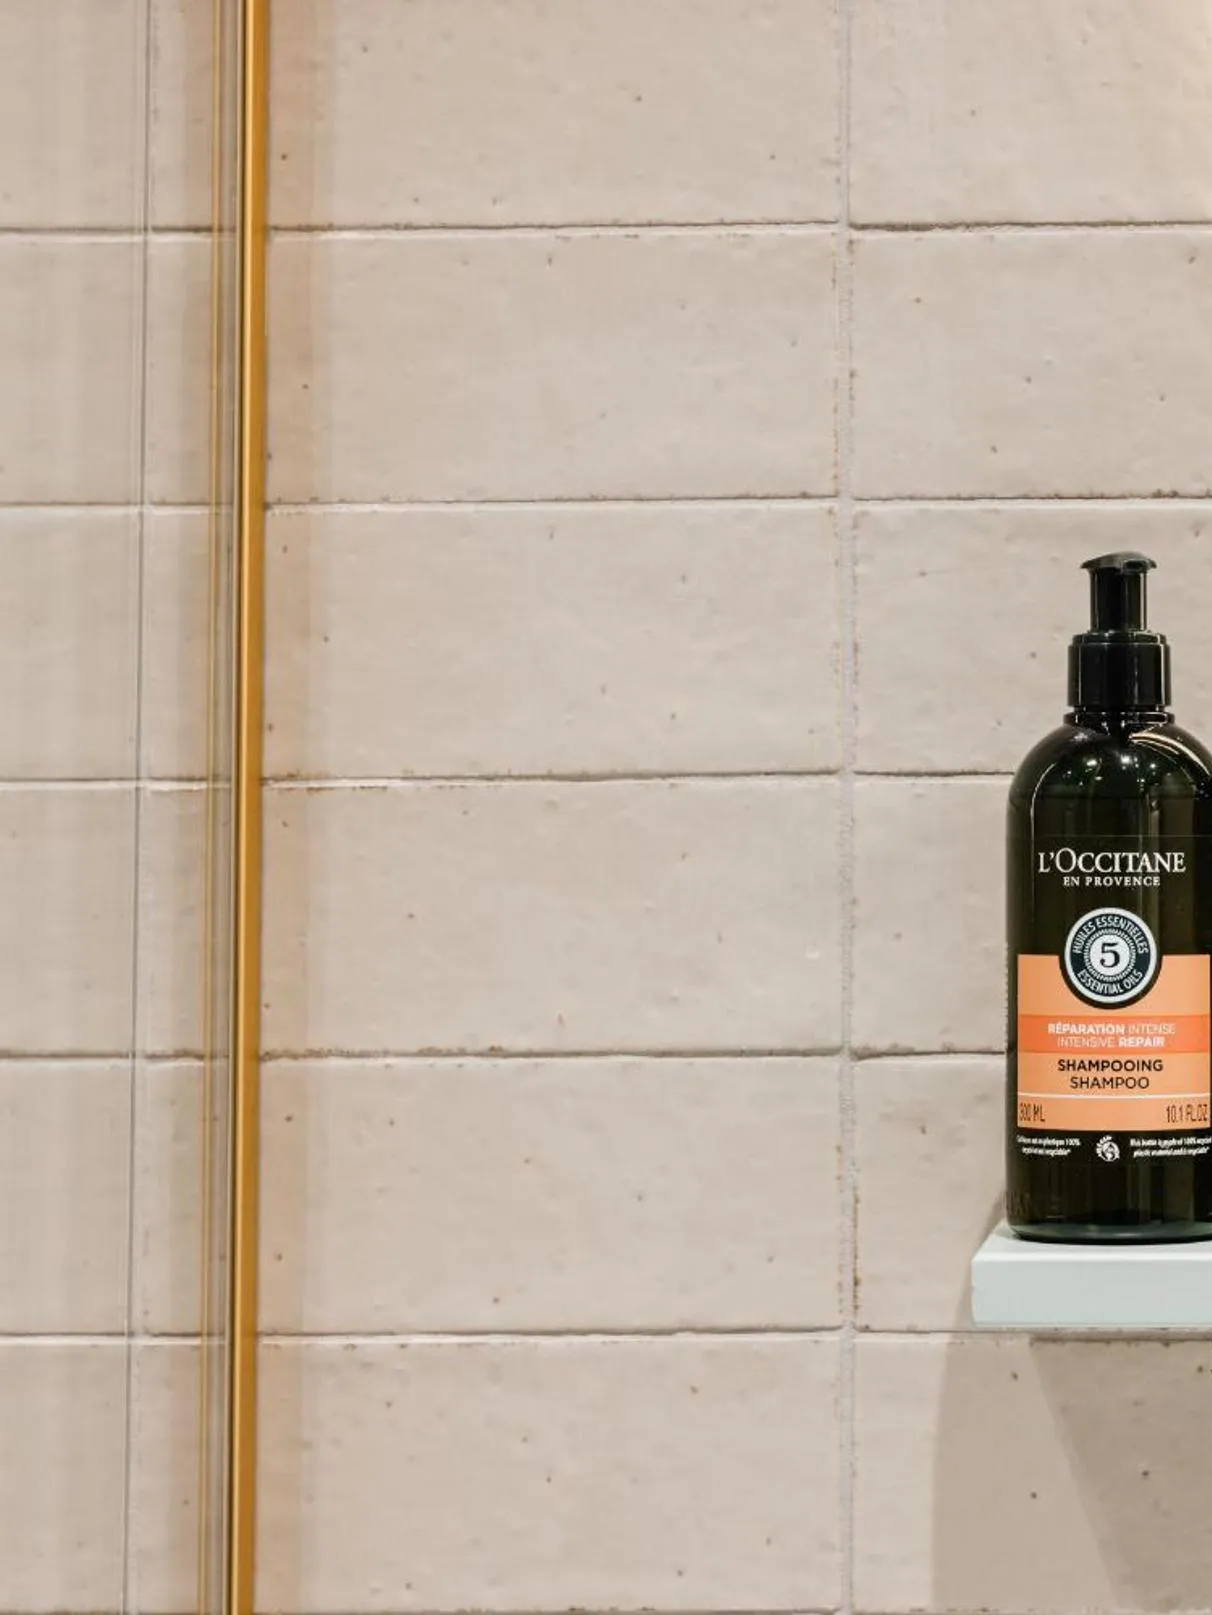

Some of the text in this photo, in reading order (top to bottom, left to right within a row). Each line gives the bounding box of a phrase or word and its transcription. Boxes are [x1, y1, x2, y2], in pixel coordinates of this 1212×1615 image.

[1038, 847, 1186, 873] L'OCCITANE
[1063, 876, 1161, 887] EN PROVENCE
[1072, 915, 1149, 954] HUILES ESSENTIELLES
[1099, 942, 1121, 968] 5
[1077, 969, 1143, 994] ESSENTIAL OILS
[1047, 1021, 1176, 1034] RÉPARATION INTENSE
[1057, 1036, 1165, 1048] INTENSIVE REPAIR
[1057, 1059, 1164, 1072] SHAMPOOING
[1070, 1076, 1150, 1089] SHAMPOO
[1033, 1104, 1046, 1122] ML
